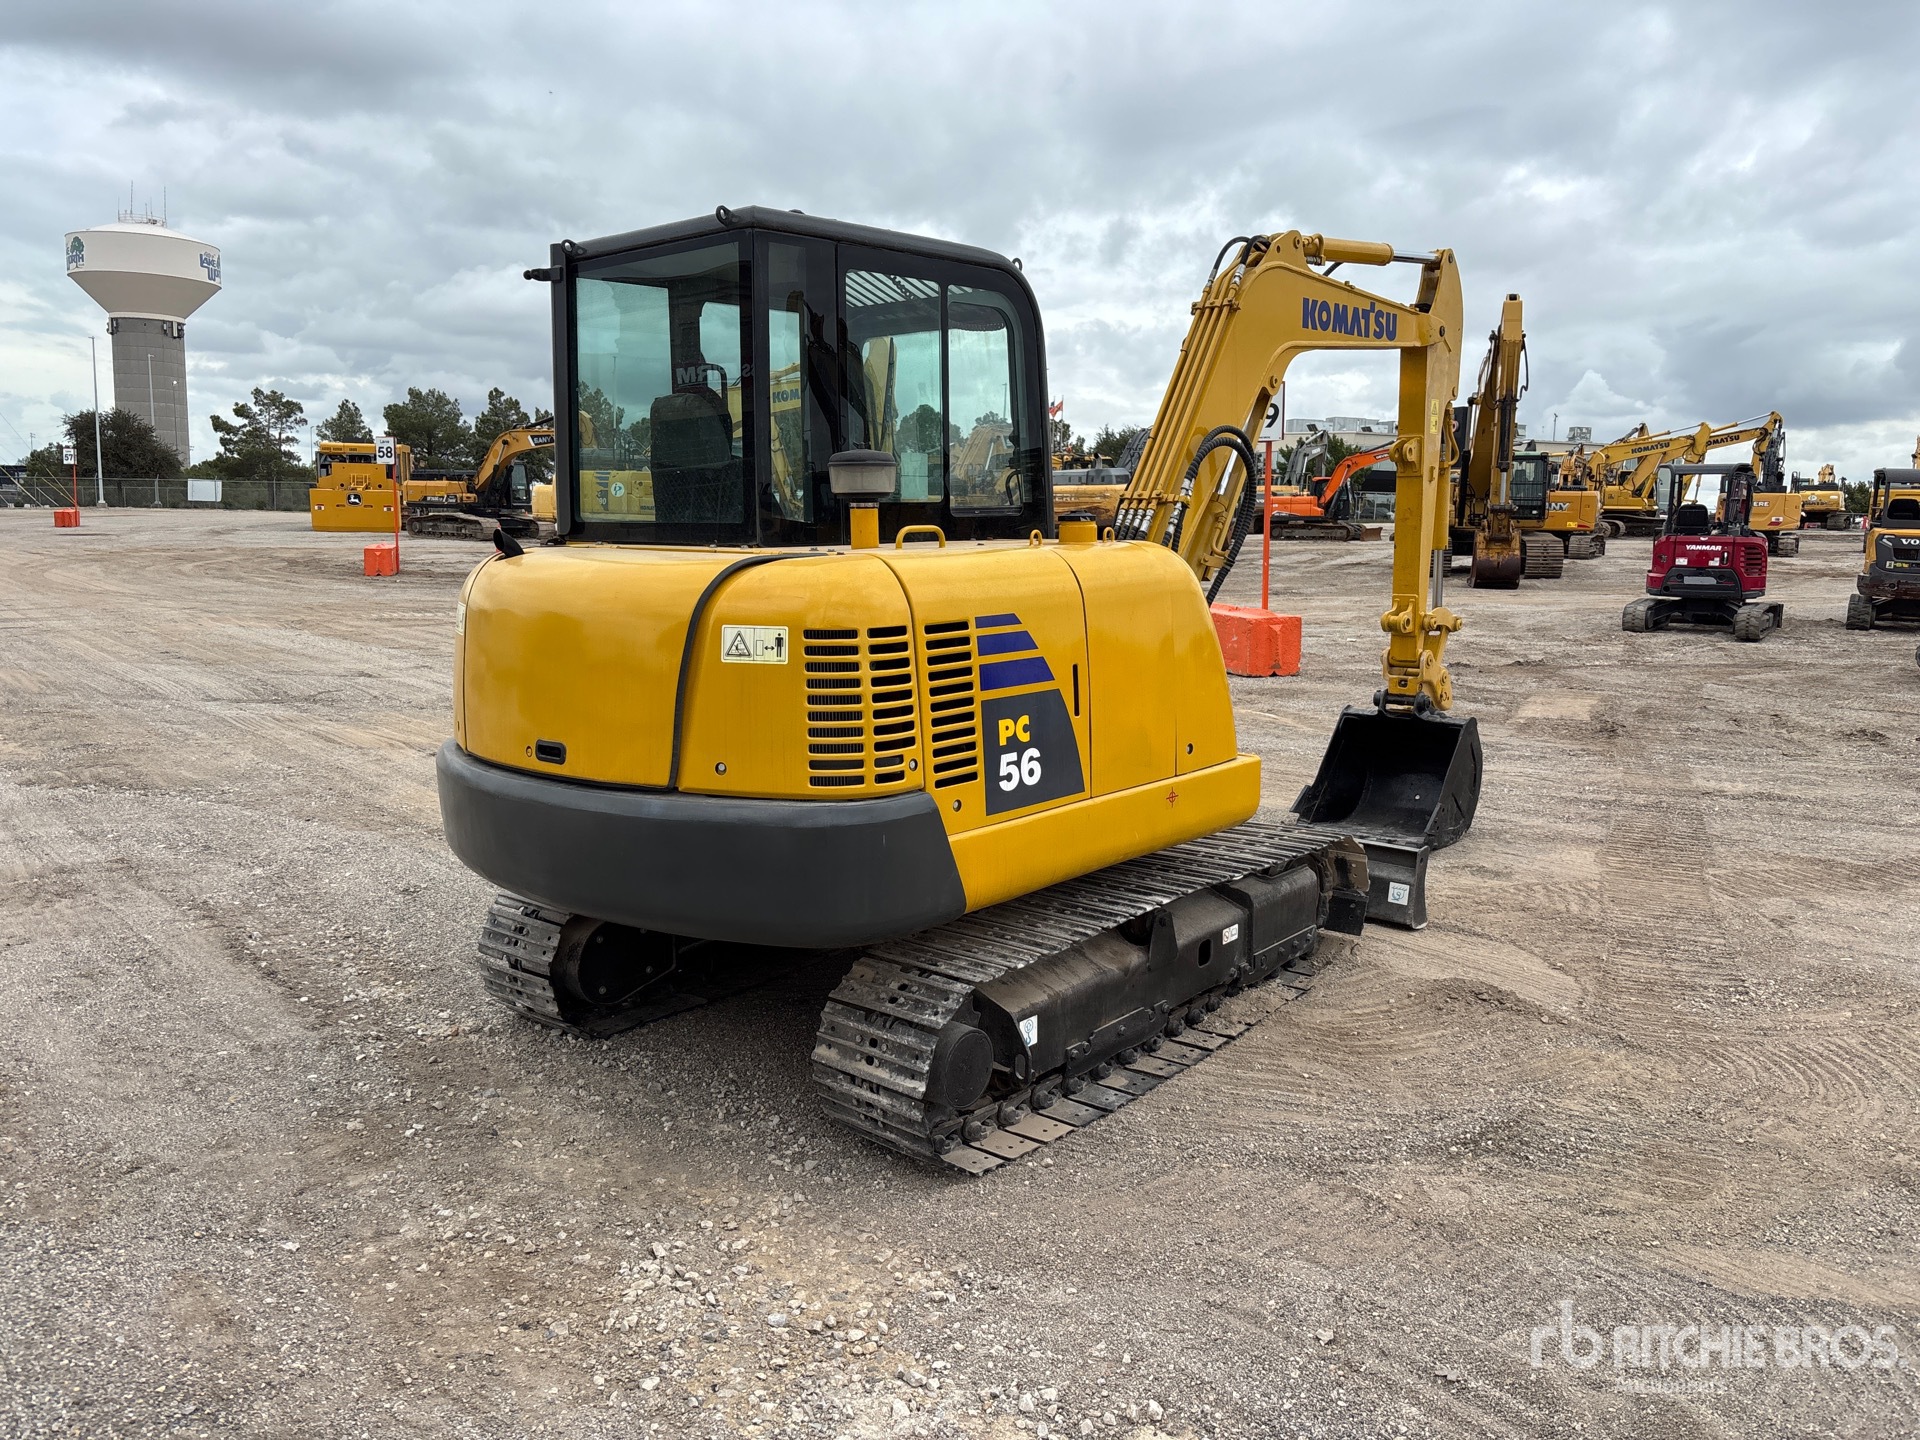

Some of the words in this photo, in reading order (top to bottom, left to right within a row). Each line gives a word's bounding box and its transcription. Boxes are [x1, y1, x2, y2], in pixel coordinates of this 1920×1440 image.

[1301, 297, 1398, 341] KOMATSU
[772, 388, 800, 404] KOM
[533, 436, 551, 444] SANY
[1706, 434, 1740, 446] OMATSU
[377, 446, 393, 458] 58
[1631, 442, 1670, 454] KOMATSU
[64, 453, 73, 461] 57
[1900, 538, 1920, 546] VO
[998, 714, 1031, 747] PC
[998, 747, 1042, 791] 56
